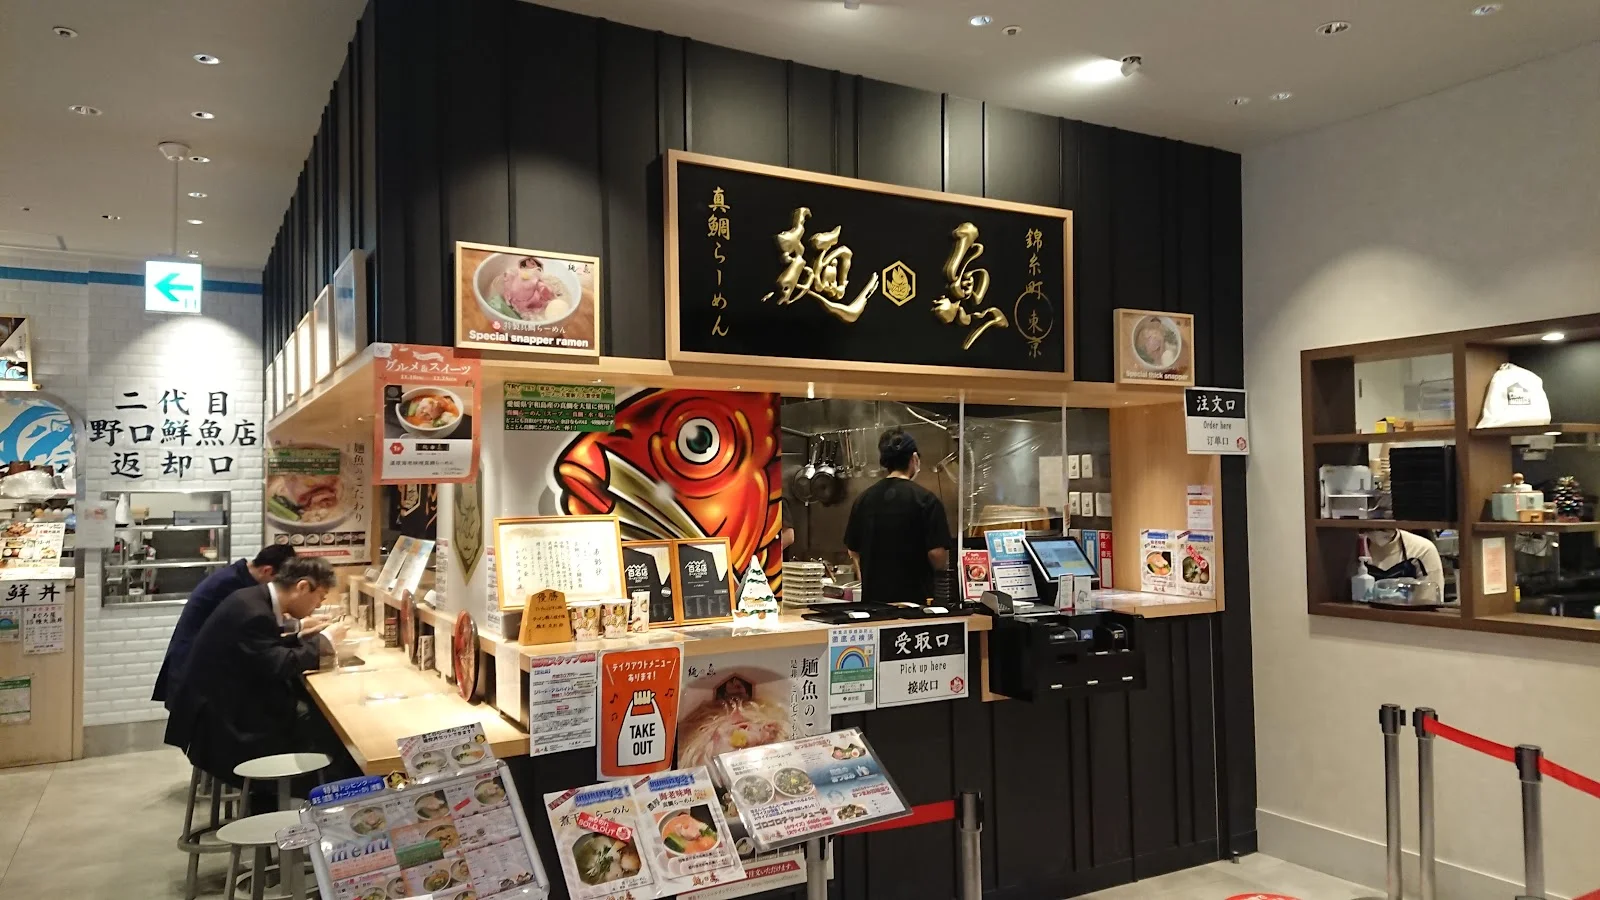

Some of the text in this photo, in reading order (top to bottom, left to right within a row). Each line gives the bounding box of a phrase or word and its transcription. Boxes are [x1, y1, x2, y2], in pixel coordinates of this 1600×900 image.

[707, 185, 731, 338] 真鯛らーめん
[469, 330, 589, 347] Special snapper ramen
[1126, 370, 1189, 381] Special thick snapper
[115, 389, 228, 416] 二代目
[1196, 395, 1236, 414] 注文口
[89, 419, 257, 446] 野口鮮魚店
[1203, 420, 1232, 430] Order here
[1207, 436, 1229, 446] 订单口
[110, 451, 233, 478] 返却口
[894, 631, 950, 655] 受取口
[612, 660, 671, 672] テイクアウトメニュー
[900, 661, 947, 674] Pick up here
[628, 671, 656, 682] あります!
[907, 680, 939, 695] 接收口
[629, 723, 656, 739] TAKE
[633, 740, 653, 755] OUT
[578, 818, 616, 836] SOLD OUT
[331, 838, 390, 863] menu
